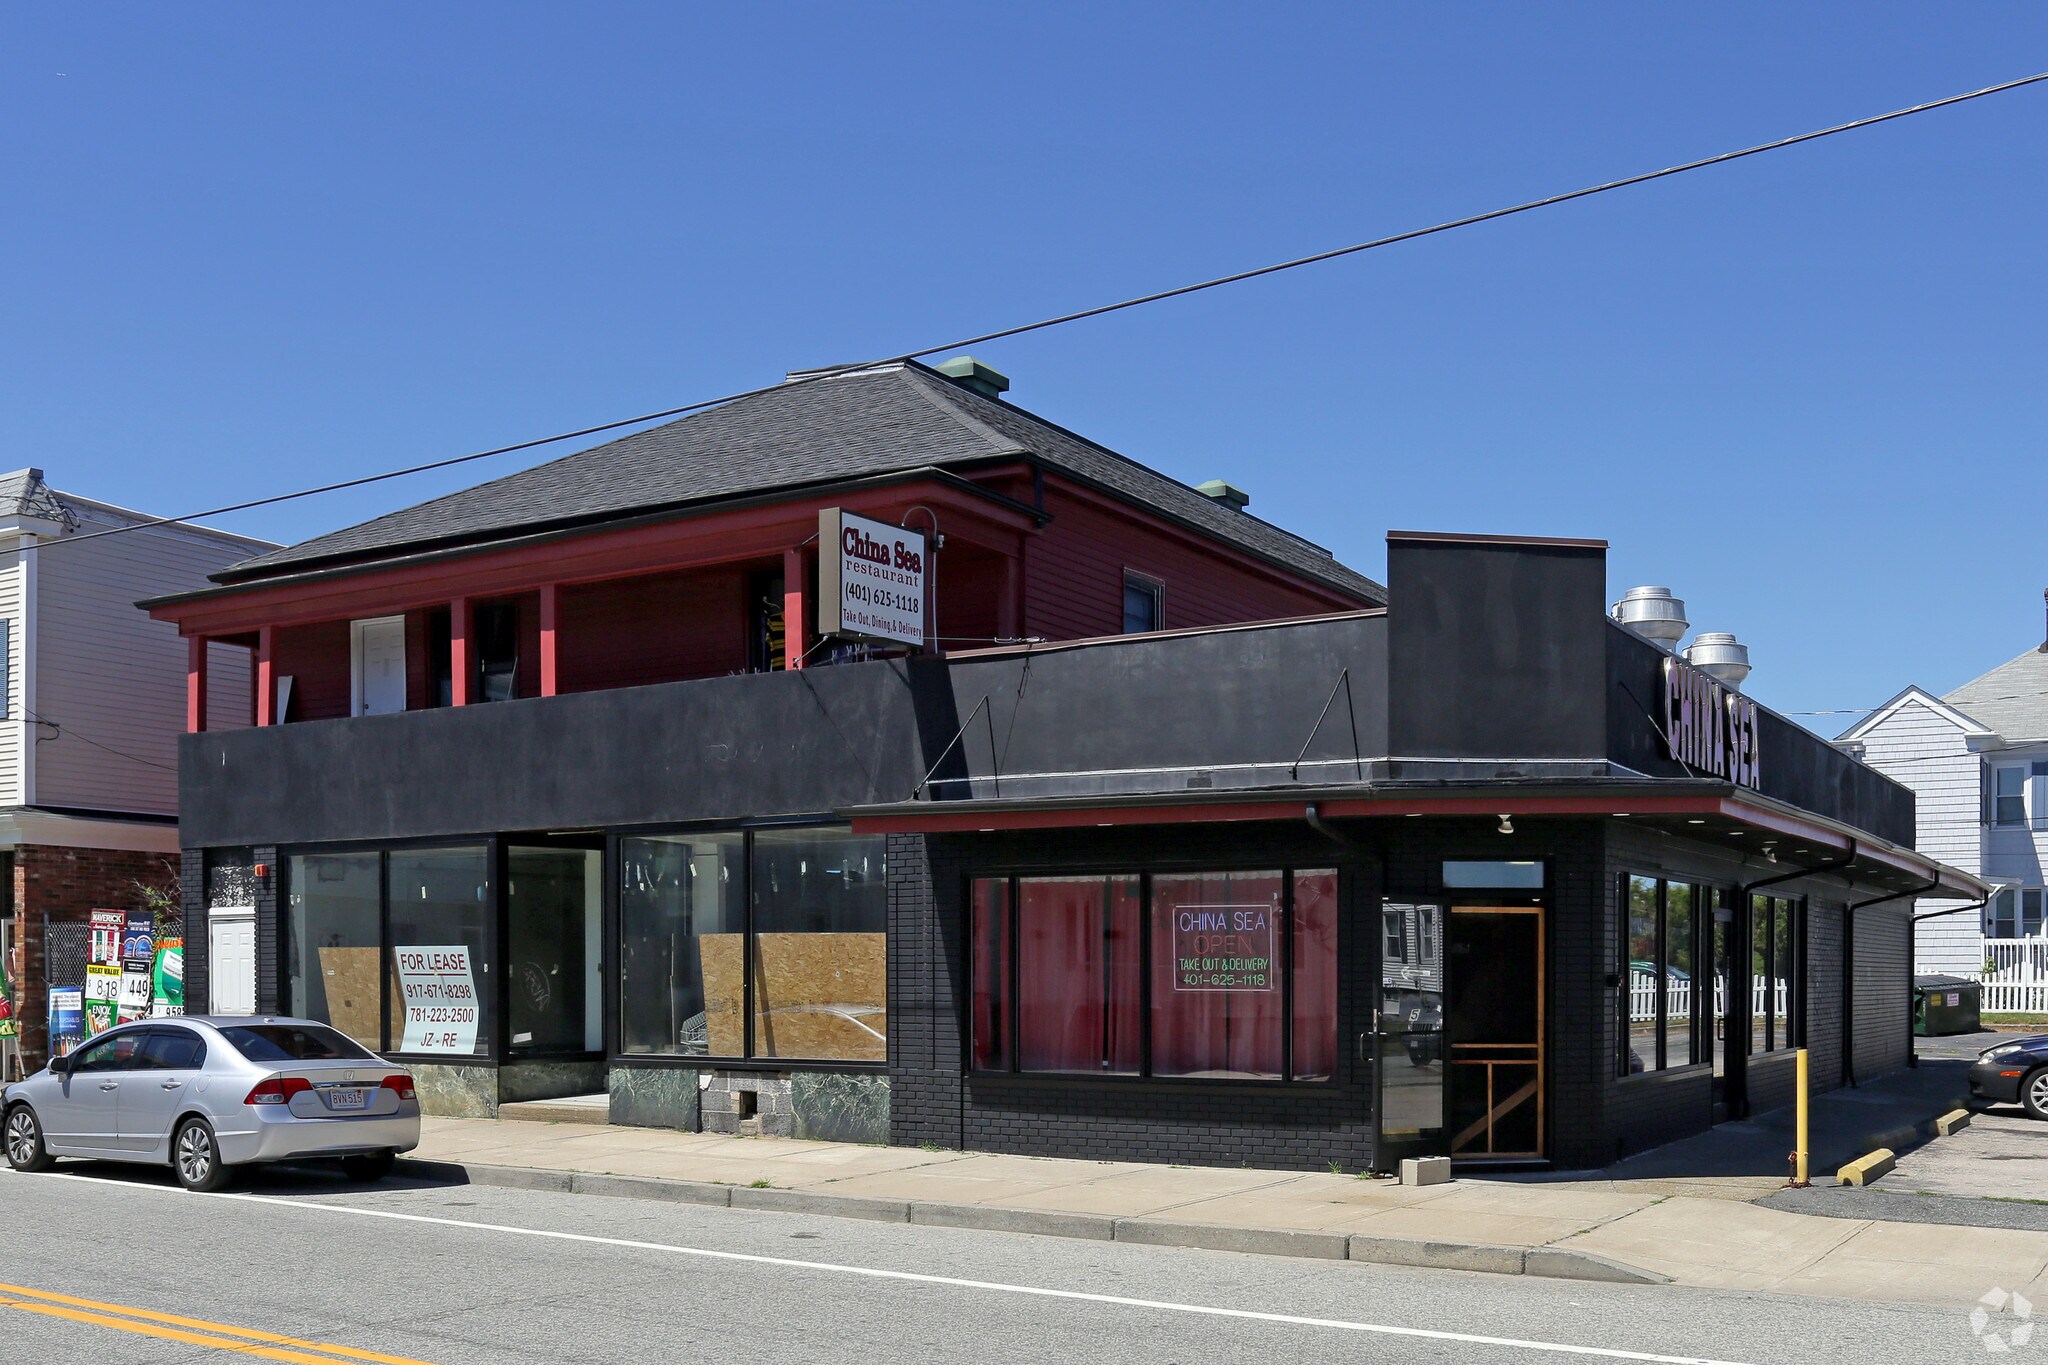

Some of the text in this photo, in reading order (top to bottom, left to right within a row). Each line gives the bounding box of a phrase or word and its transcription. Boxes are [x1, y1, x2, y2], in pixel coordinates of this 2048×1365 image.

[842, 526, 922, 574] China Sea
[845, 559, 919, 587] restaurant
[845, 581, 919, 614] (401) 625-1118
[843, 608, 857, 623] Take
[858, 612, 871, 628] Out,
[898, 621, 922, 640] Delivery
[1664, 656, 1760, 790] CHINA SEA
[92, 913, 121, 923] MAVERICK
[1180, 911, 1266, 932] CHINA SEA
[1194, 935, 1252, 955] OPEN
[400, 953, 466, 970] FOR LEASE
[1179, 957, 1269, 971] TAKE OUT & DELIVERY
[89, 966, 119, 976] GREAT VALUE
[1183, 973, 1266, 986] 401-625-1118
[406, 984, 472, 999] 917-671-8298
[410, 1007, 474, 1023] 781-223-2500
[420, 1032, 434, 1047] JZ
[441, 1032, 457, 1047] RE
[348, 1094, 363, 1104] 515
